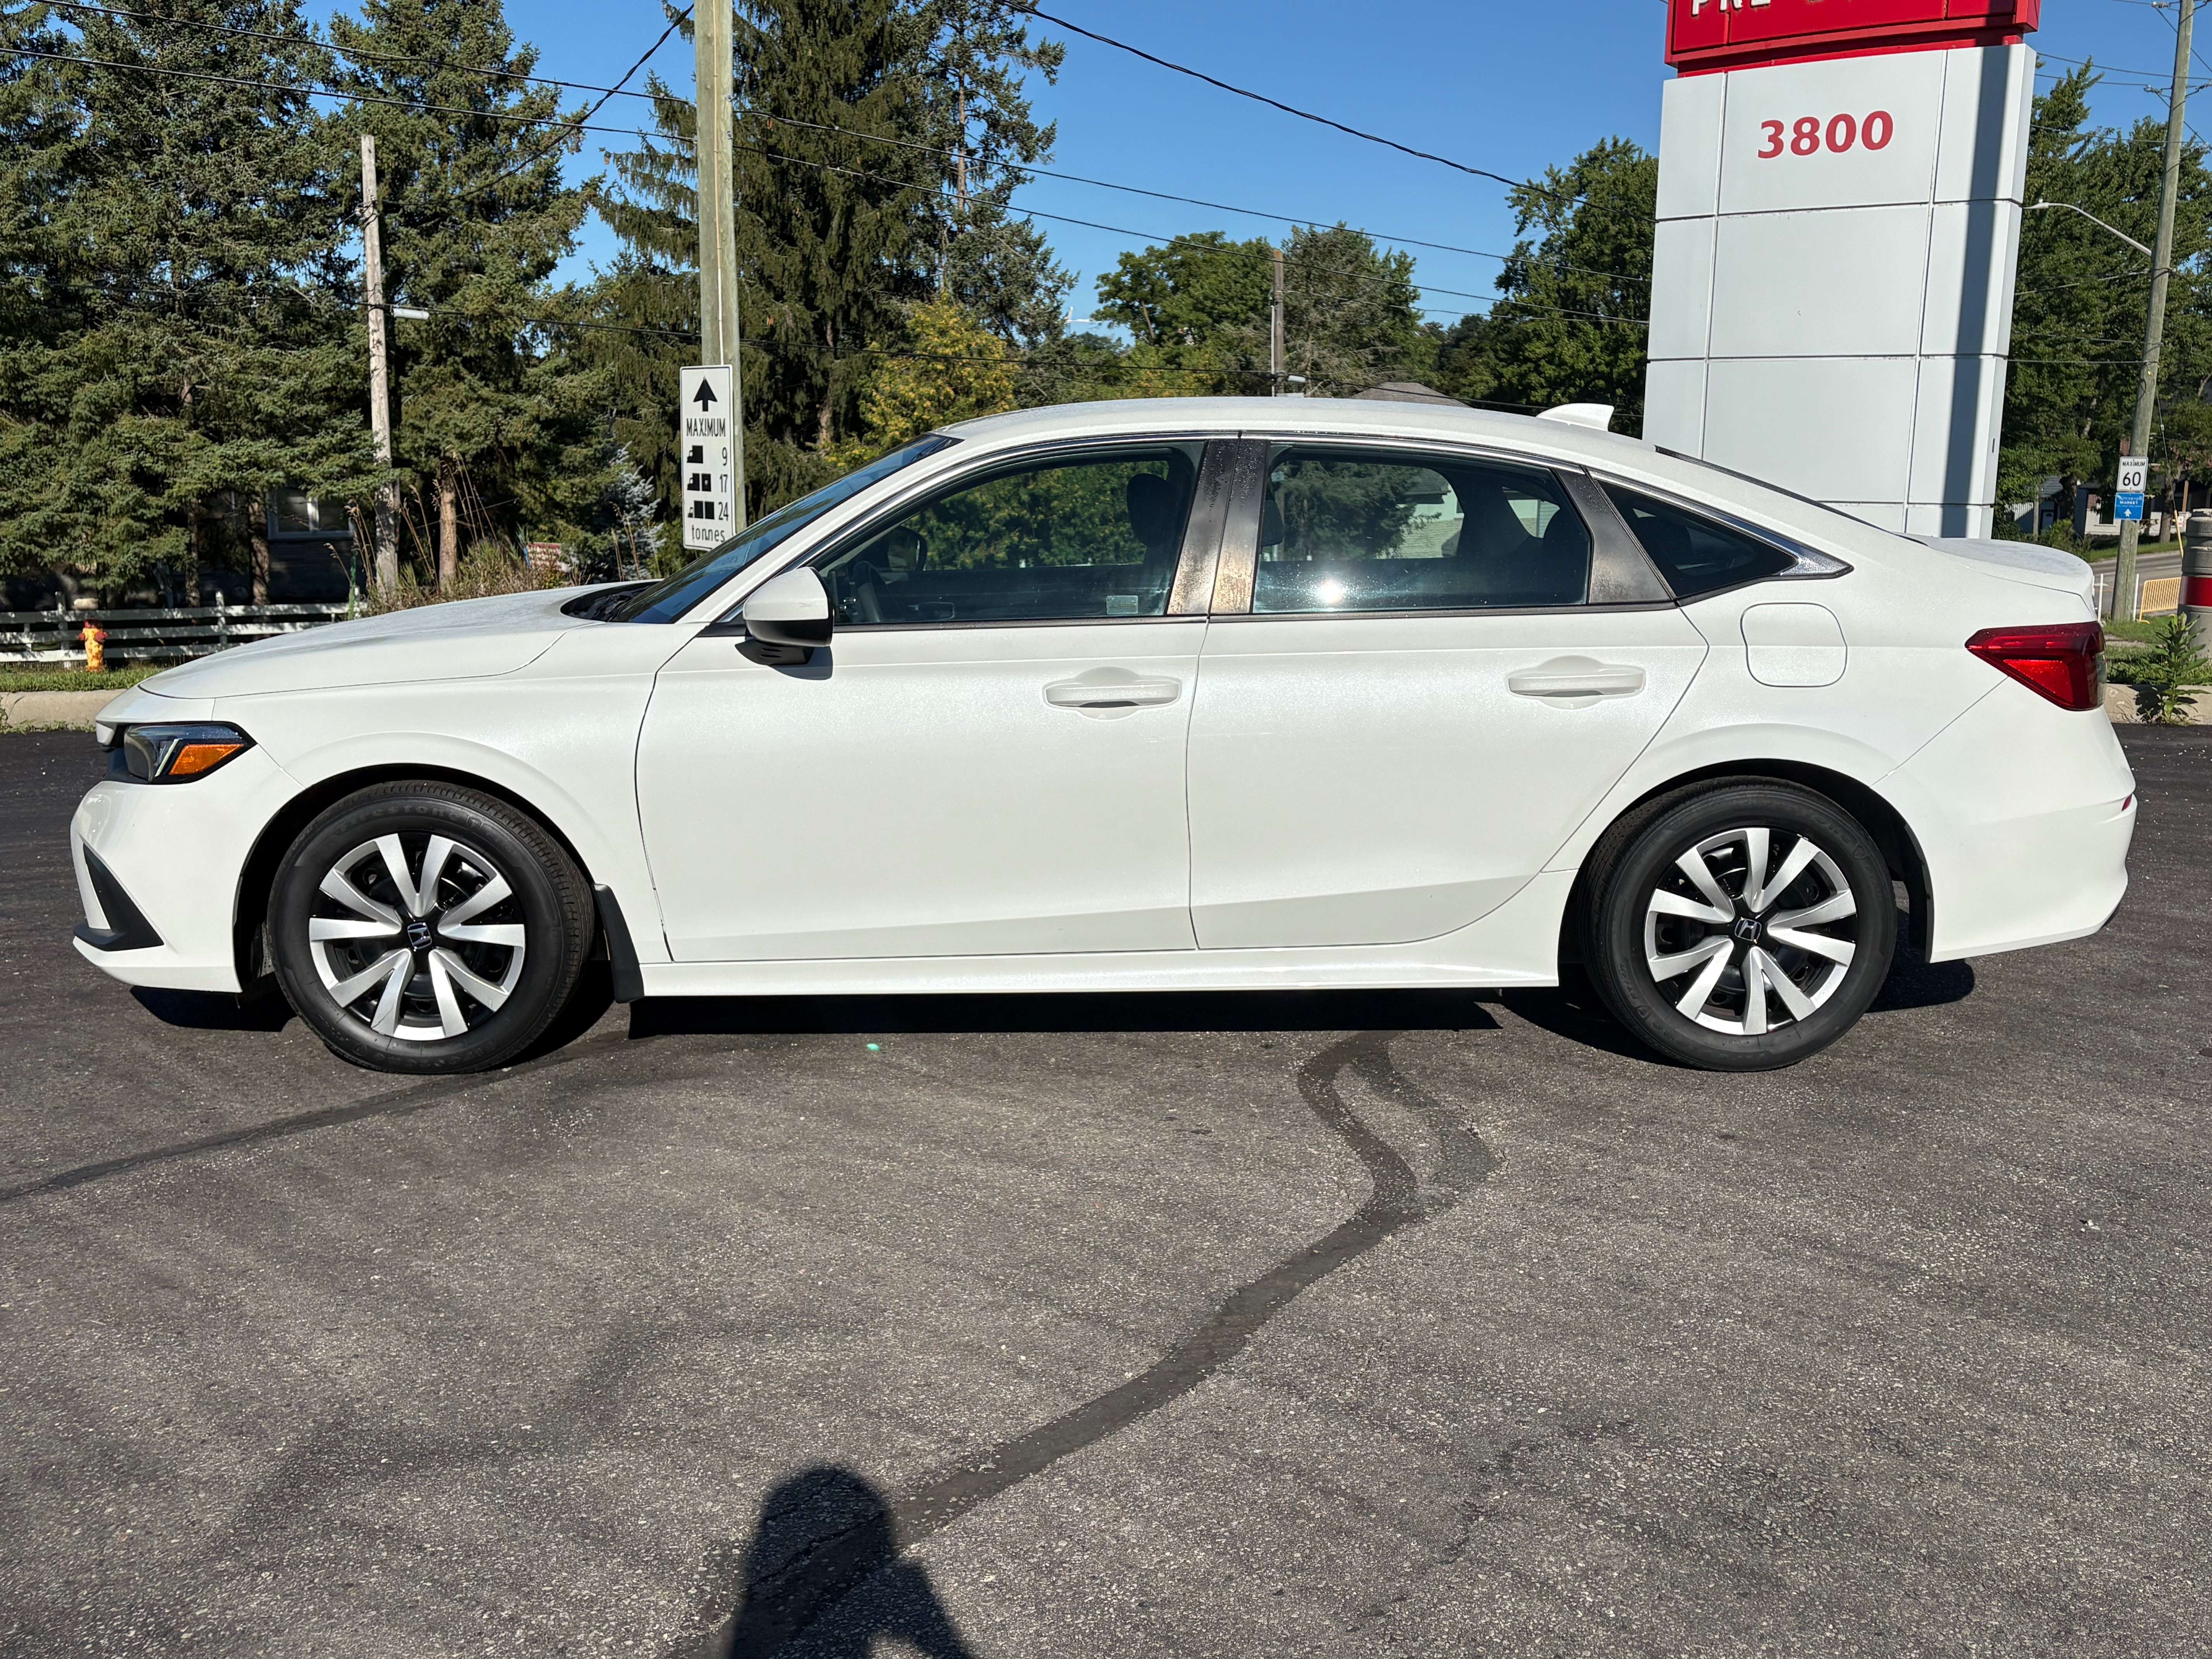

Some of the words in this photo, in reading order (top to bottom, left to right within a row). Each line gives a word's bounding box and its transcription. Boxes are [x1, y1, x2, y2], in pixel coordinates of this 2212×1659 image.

[1758, 110, 1893, 159] 3800
[686, 418, 726, 437] MAXIMUM
[722, 447, 728, 466] 9
[719, 474, 728, 493] 17
[2123, 472, 2142, 486] 60
[718, 501, 729, 521] 24
[692, 525, 726, 542] tonnes
